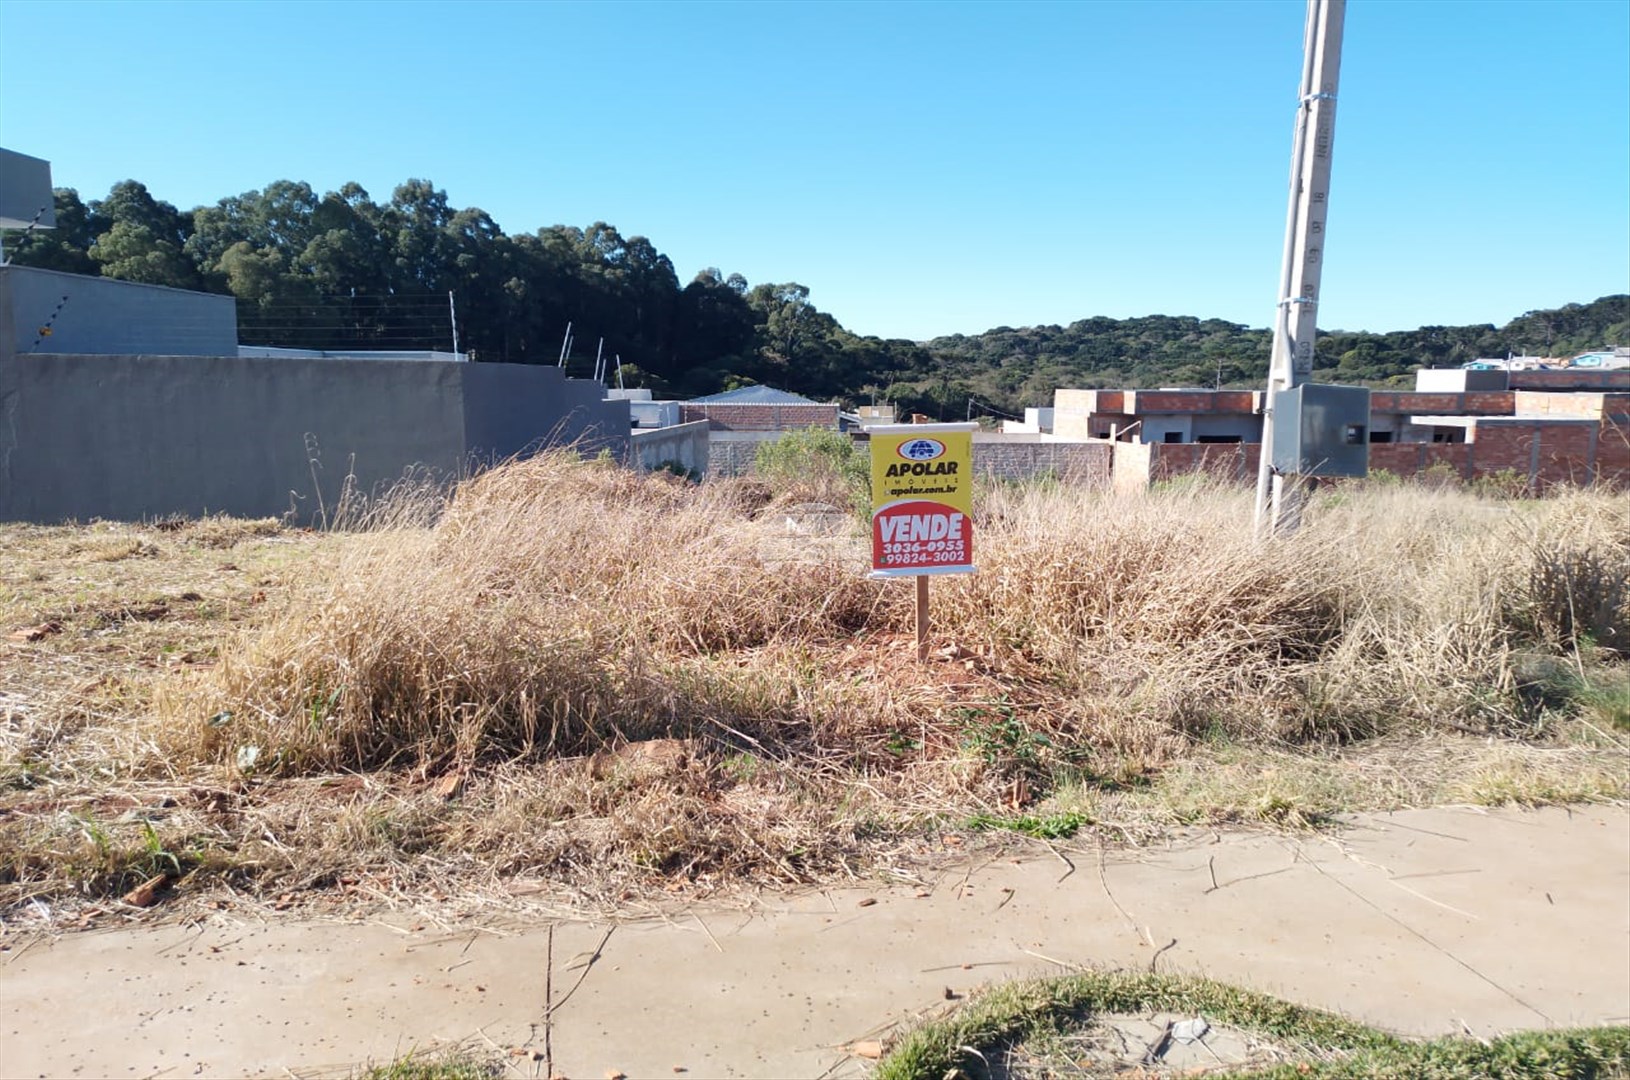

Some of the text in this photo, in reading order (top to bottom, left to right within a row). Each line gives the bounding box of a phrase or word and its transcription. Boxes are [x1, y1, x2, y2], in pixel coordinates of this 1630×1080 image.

[886, 461, 959, 478] APOLAR
[890, 484, 958, 497] apolar.com.br
[879, 513, 964, 543] VENDE
[883, 540, 965, 554] 3036-0955
[886, 550, 965, 564] 99824-3002
